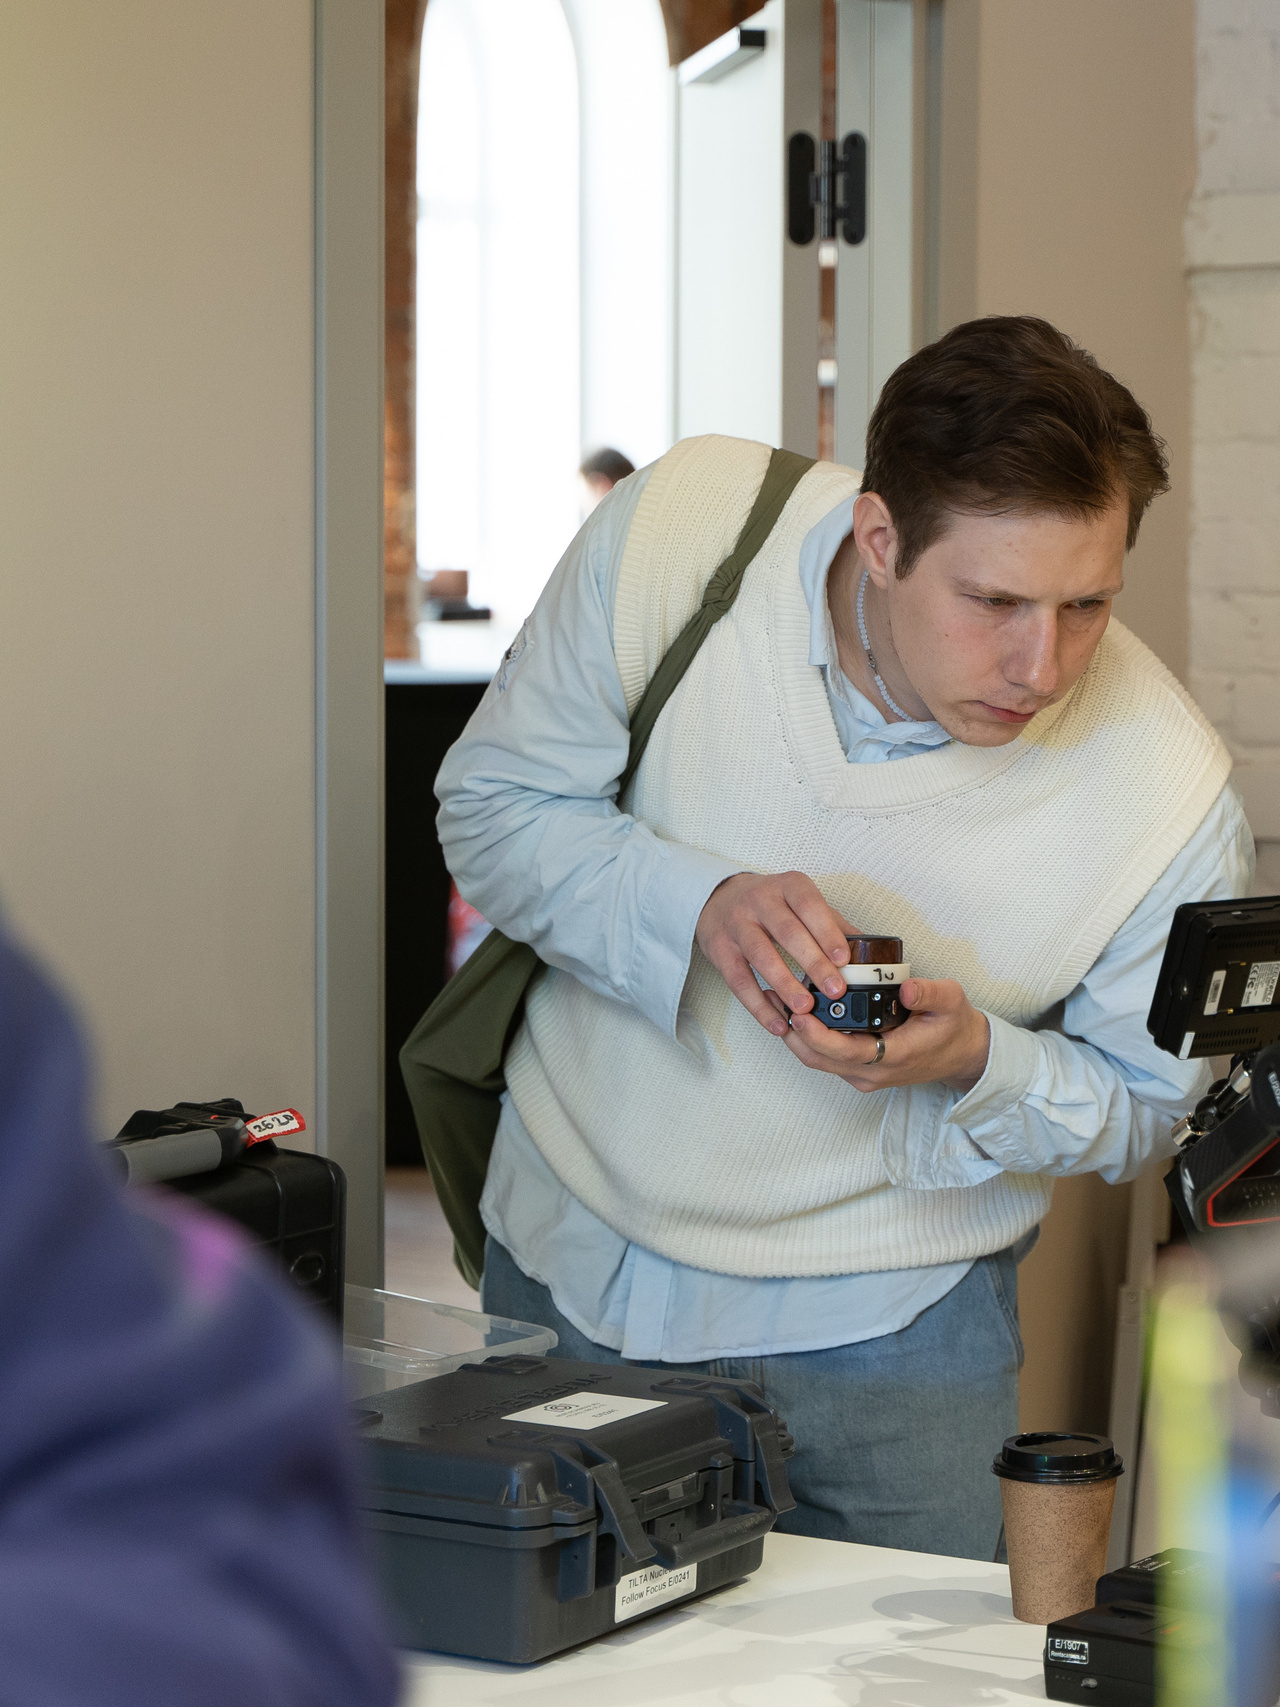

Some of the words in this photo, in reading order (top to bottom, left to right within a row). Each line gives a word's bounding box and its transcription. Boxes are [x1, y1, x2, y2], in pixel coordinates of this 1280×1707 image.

[621, 1592, 645, 1606] Follow
[646, 1583, 666, 1597] Focus
[668, 1570, 690, 1587] E/0241
[628, 1573, 648, 1589] TILTA
[1055, 1639, 1081, 1651] E/1907
